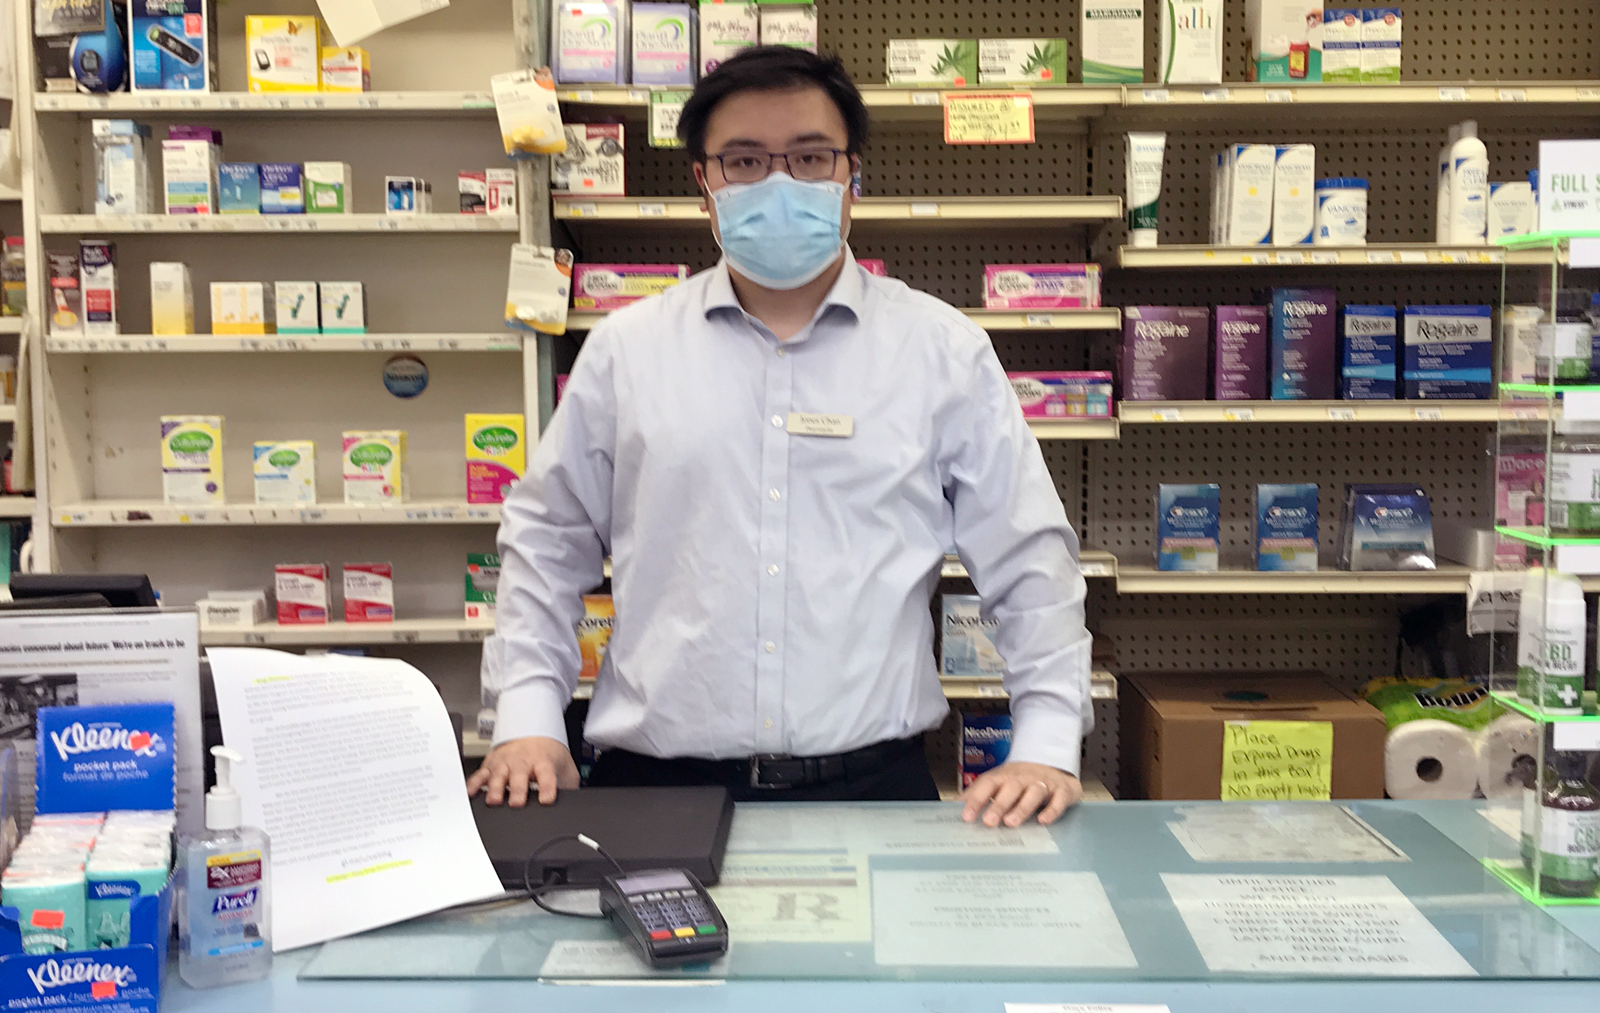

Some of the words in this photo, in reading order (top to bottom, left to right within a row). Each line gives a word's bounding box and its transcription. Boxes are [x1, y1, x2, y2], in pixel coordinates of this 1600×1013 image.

[1551, 174, 1589, 193] FULL
[1282, 299, 1328, 319] Rogaine
[1133, 318, 1191, 340] Rogaine
[1221, 319, 1261, 338] Rogaine
[1350, 316, 1393, 333] Rogaine
[1415, 318, 1480, 340] Rogaine
[1229, 724, 1279, 746] Place
[74, 761, 110, 772] pocket
[112, 759, 138, 772] pack
[1232, 746, 1282, 766] Expired
[1284, 745, 1321, 765] Drugs
[63, 772, 97, 783] format
[100, 771, 114, 781] de
[116, 769, 149, 781] poche
[95, 883, 132, 897] Kleenex
[216, 890, 256, 911] Purell
[27, 959, 130, 995] Kleenex
[8, 996, 43, 1009] pocket
[43, 994, 68, 1006] pack
[121, 987, 150, 999] poche
